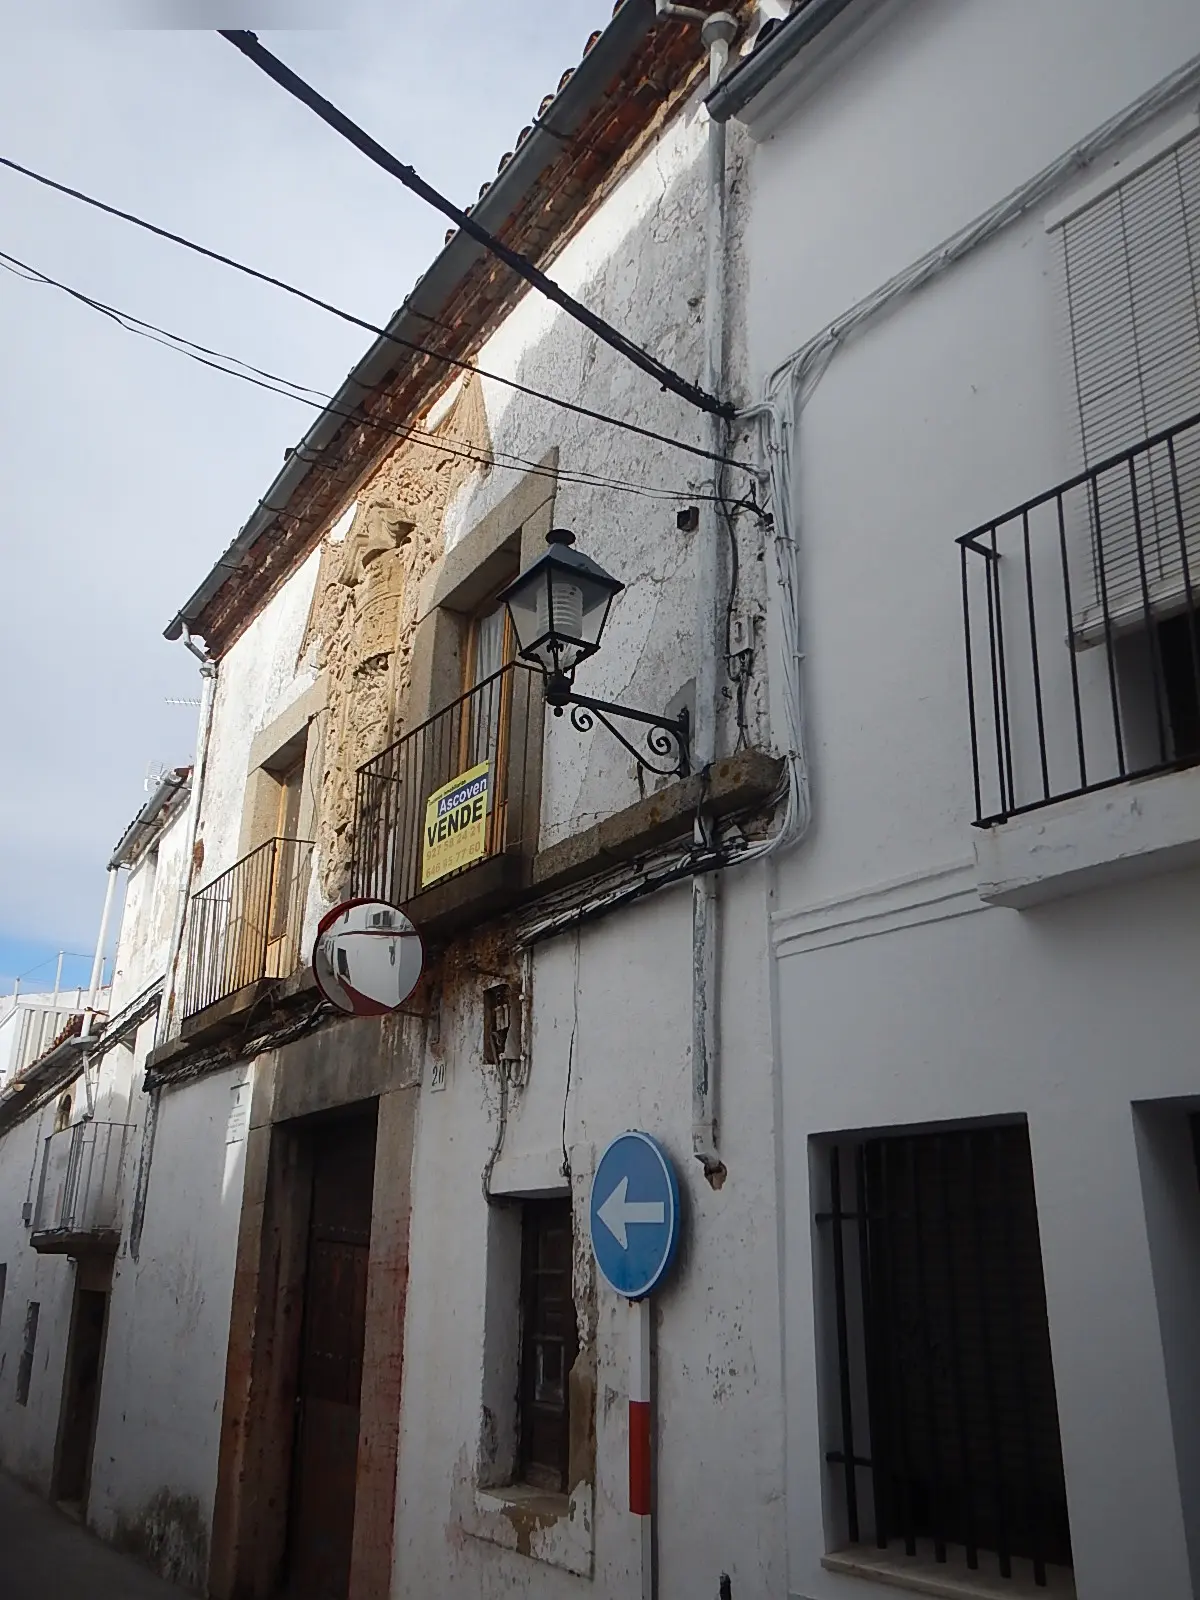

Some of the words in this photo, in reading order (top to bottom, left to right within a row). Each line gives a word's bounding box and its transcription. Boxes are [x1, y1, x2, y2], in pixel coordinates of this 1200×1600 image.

[439, 778, 487, 815] Ascoven
[427, 796, 484, 848] VENDE
[426, 843, 441, 861] 927
[470, 822, 481, 838] 21
[426, 862, 441, 878] 646
[456, 848, 467, 862] 77
[468, 841, 481, 855] 60
[432, 1063, 445, 1087] 20
